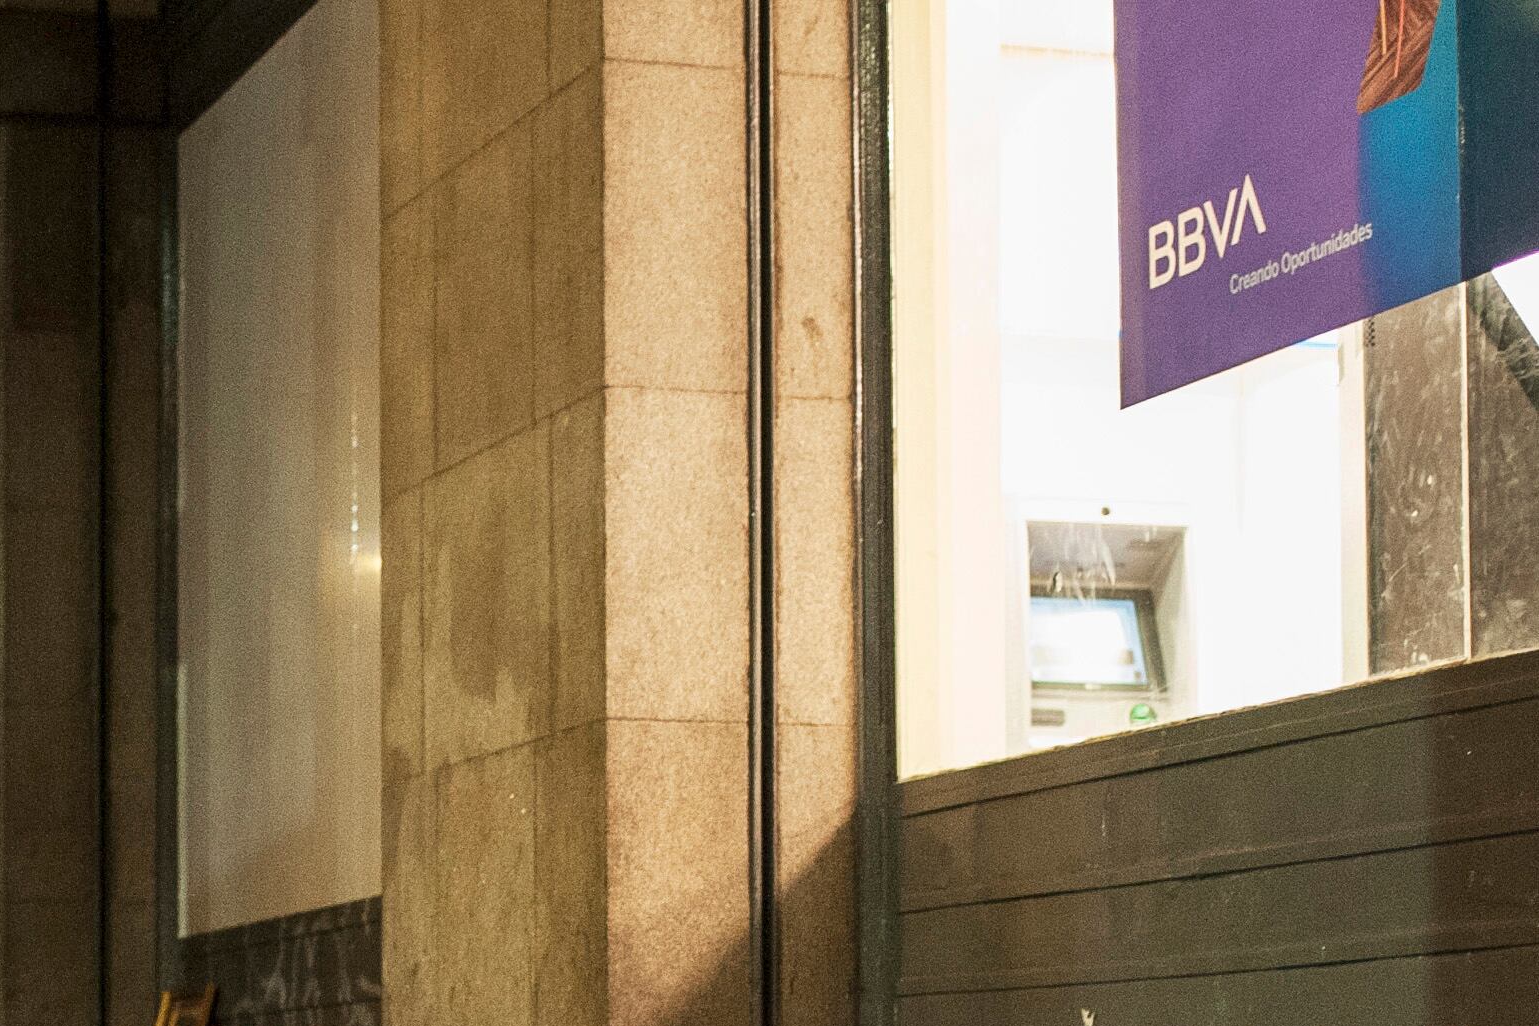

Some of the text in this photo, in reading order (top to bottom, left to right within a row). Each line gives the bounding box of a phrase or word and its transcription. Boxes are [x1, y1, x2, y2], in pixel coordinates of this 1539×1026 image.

[1149, 173, 1267, 290] BBVA
[1229, 223, 1373, 294] Creando Oportunidades
